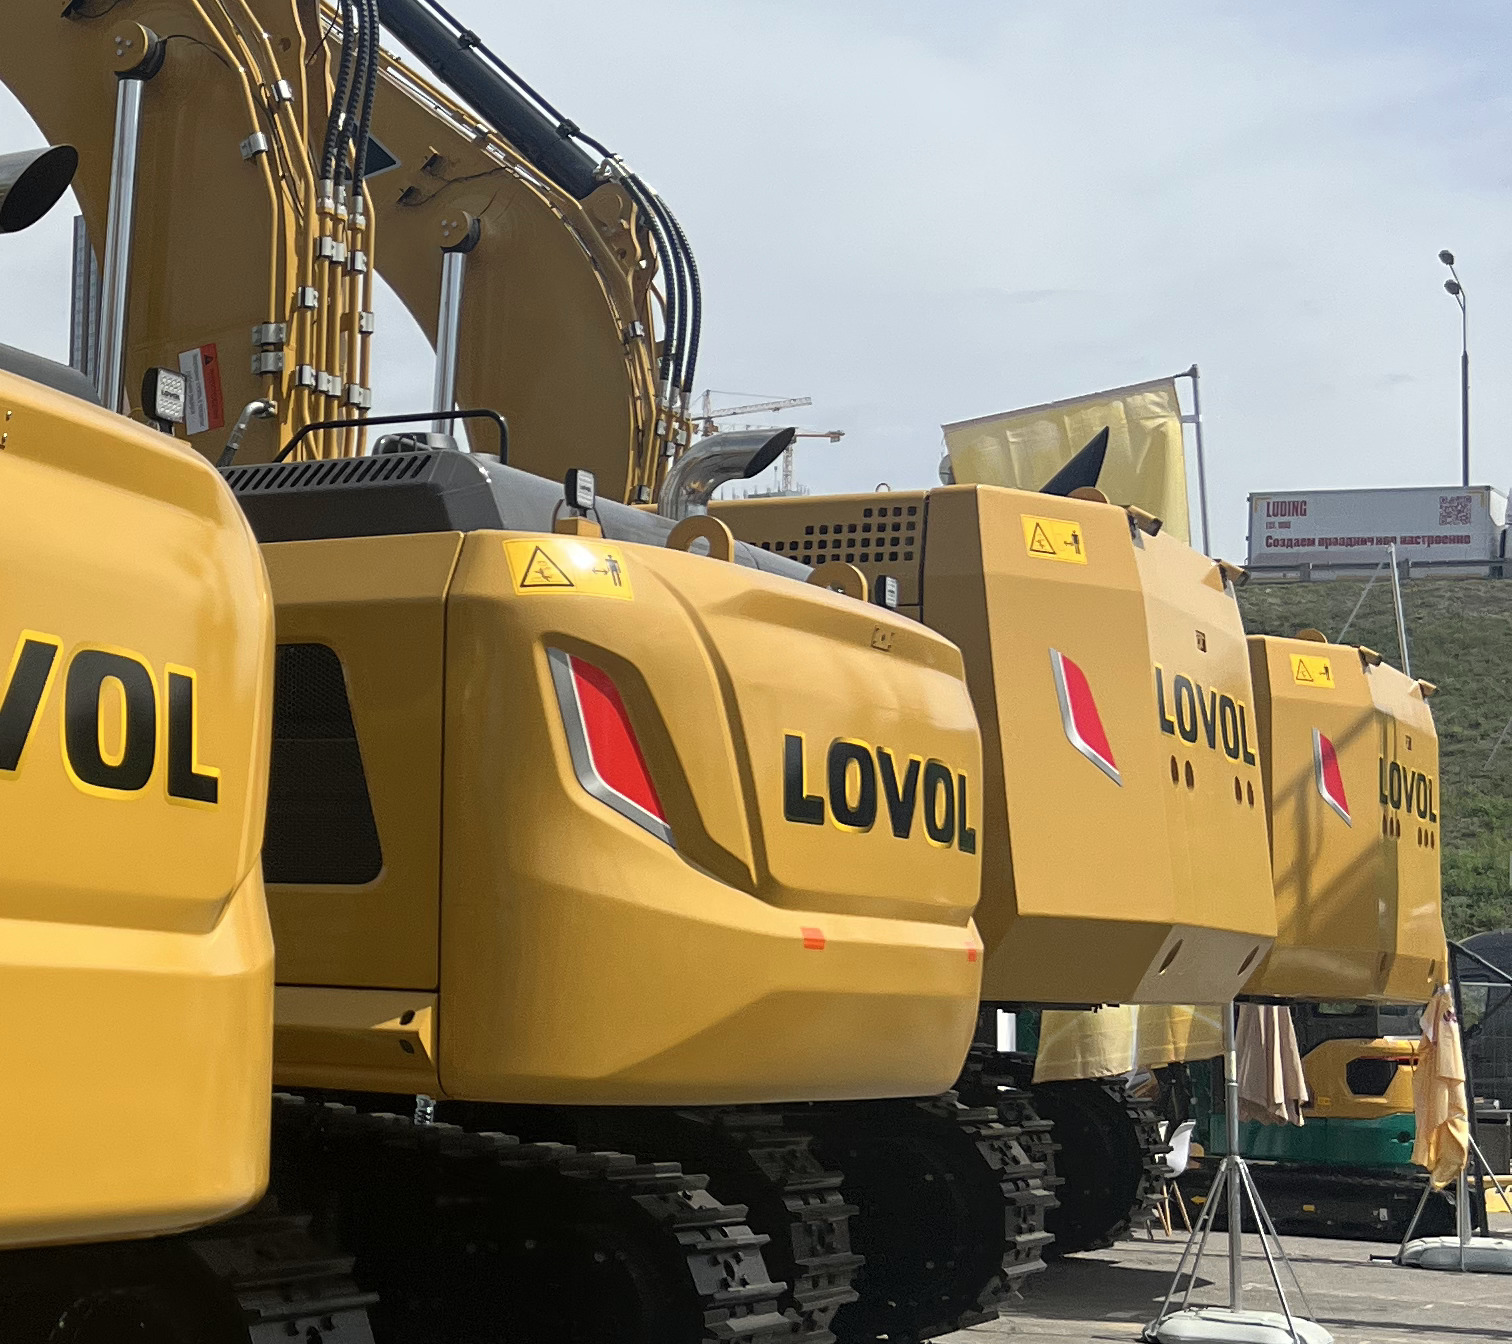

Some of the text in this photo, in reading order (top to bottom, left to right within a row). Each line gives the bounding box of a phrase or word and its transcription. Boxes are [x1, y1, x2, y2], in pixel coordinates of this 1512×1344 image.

[1265, 535, 1316, 548] Создаем
[1266, 500, 1307, 517] LUDING
[1155, 665, 1256, 767] LOVOL
[783, 733, 976, 855] LOVOL
[1378, 756, 1438, 824] LOVOL
